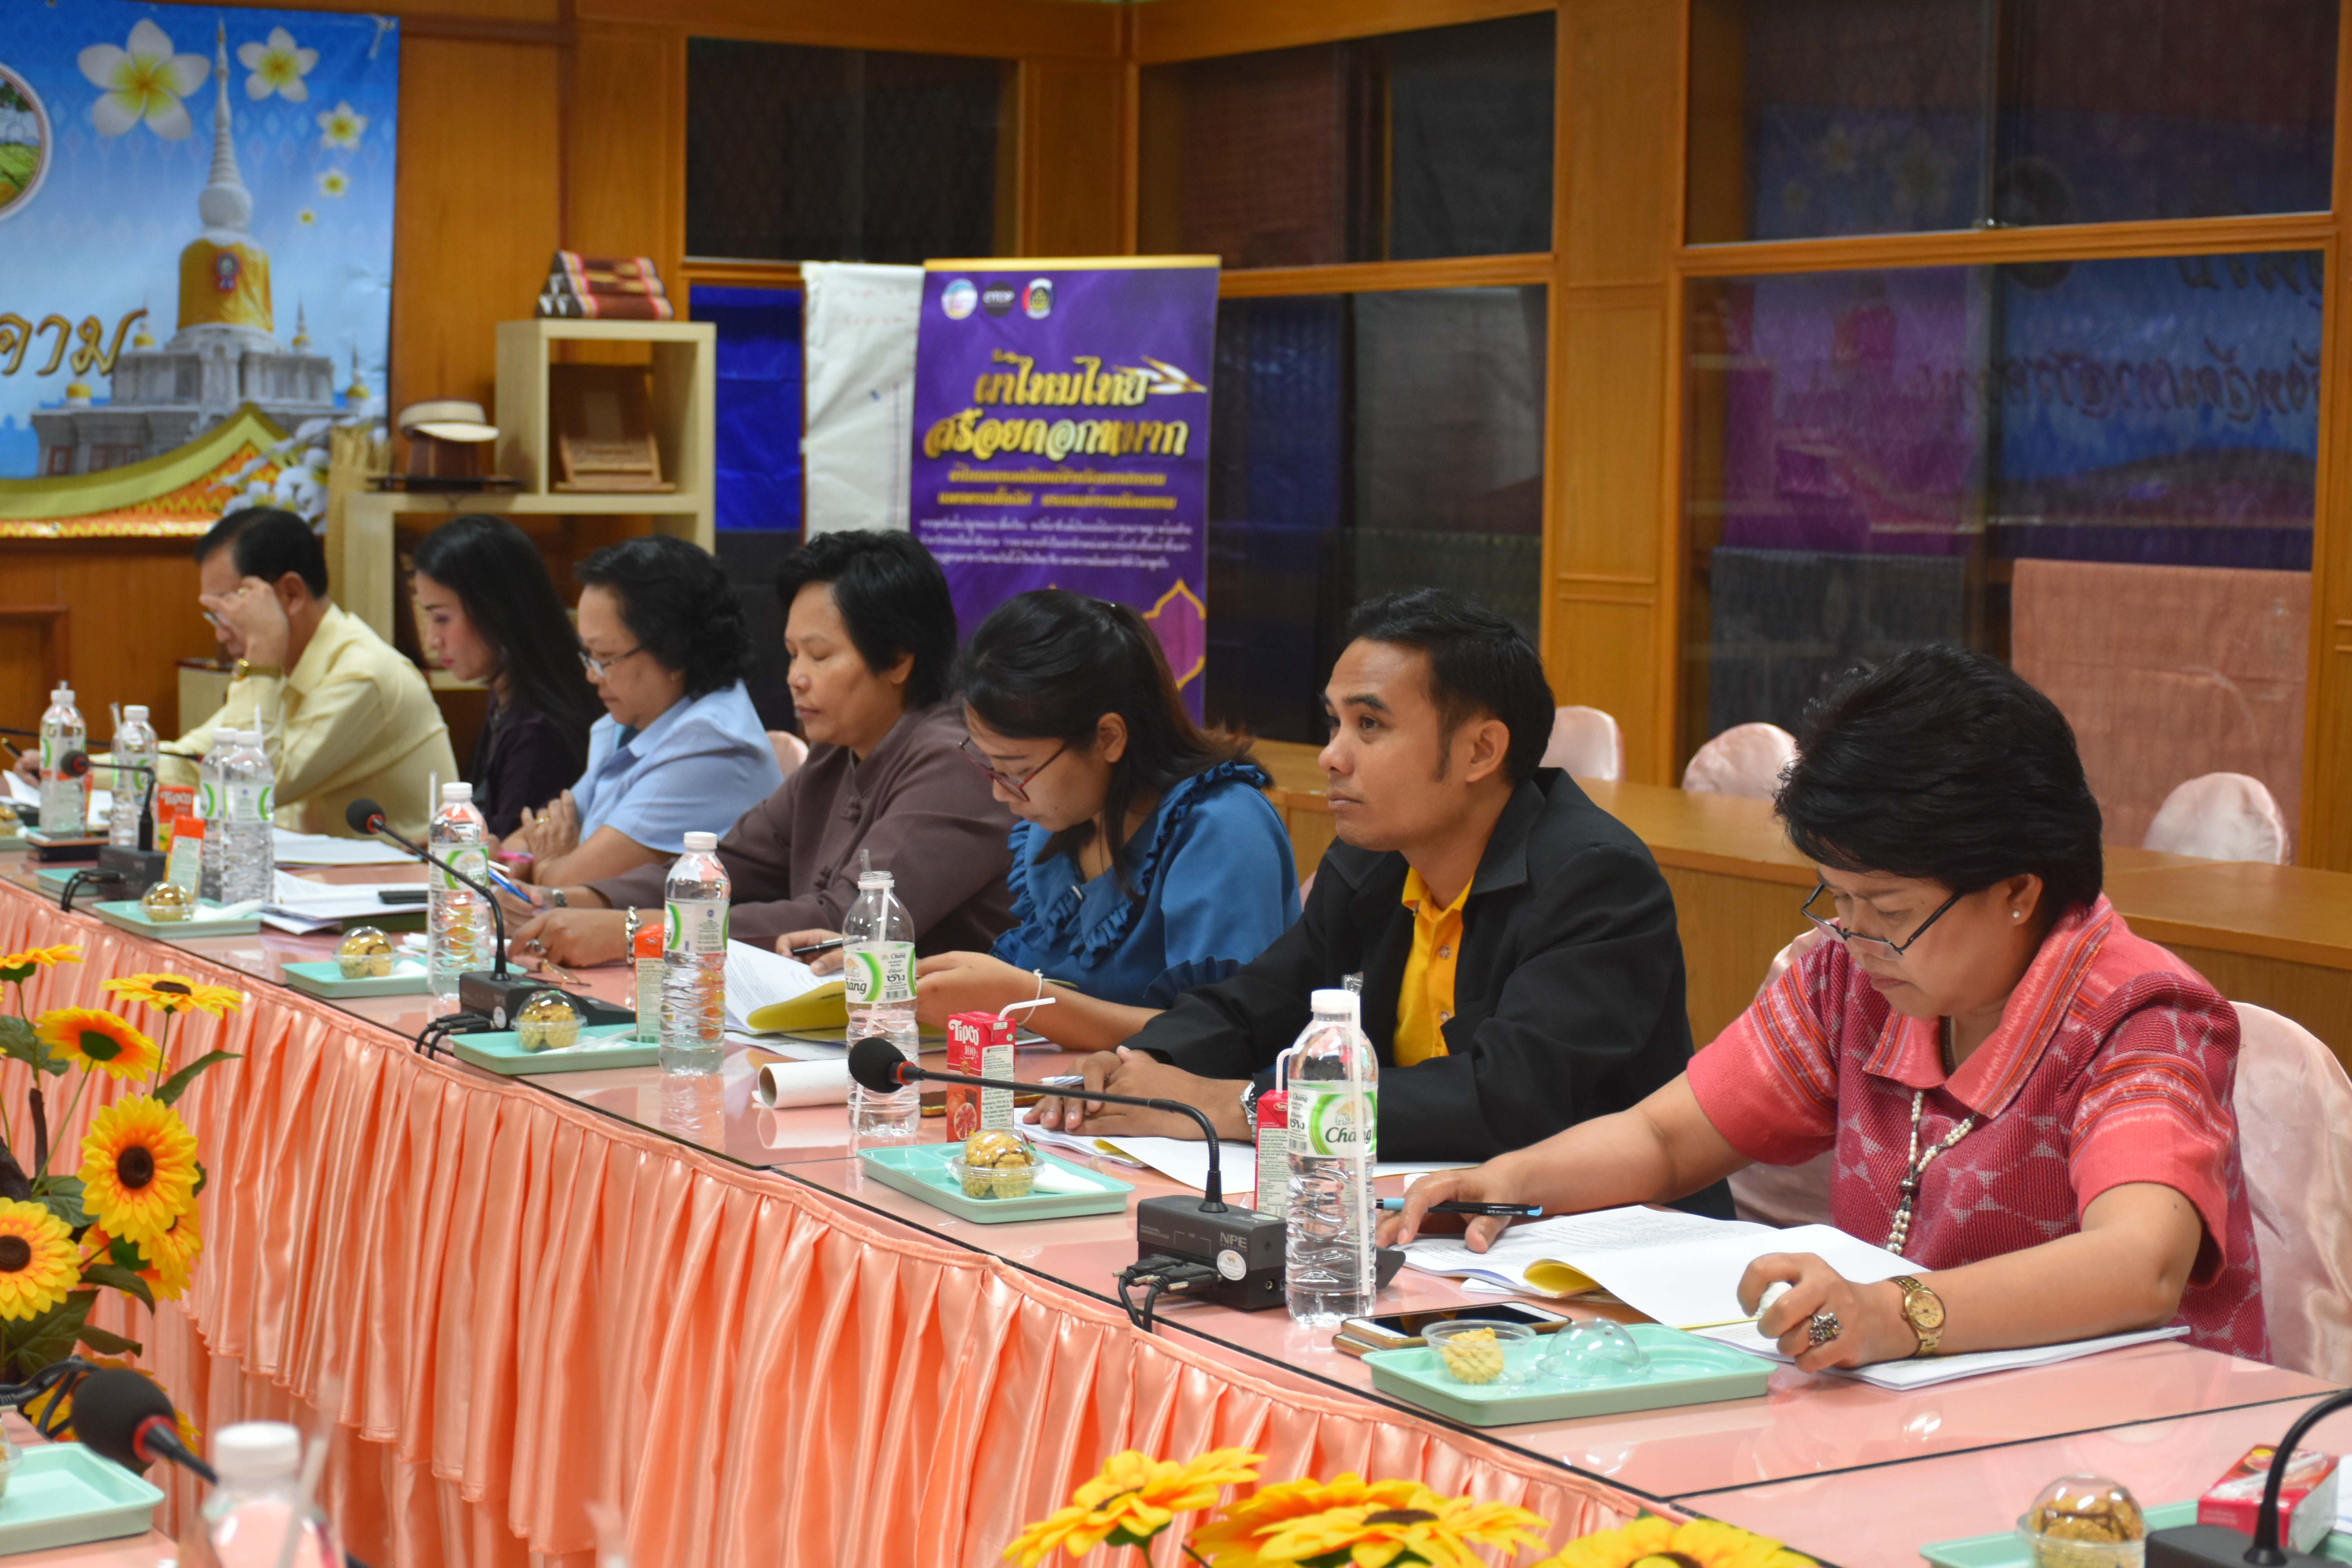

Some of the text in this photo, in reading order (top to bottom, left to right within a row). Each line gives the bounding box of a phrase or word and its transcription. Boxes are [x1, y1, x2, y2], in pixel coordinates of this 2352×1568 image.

[974, 348, 1151, 406] ผ้าไหมไทย
[924, 407, 1189, 461] สร้อยดอกหมาก
[949, 1019, 979, 1046] Tipco
[1325, 1127, 1372, 1144] Chag
[1220, 1232, 1247, 1249] NPE
